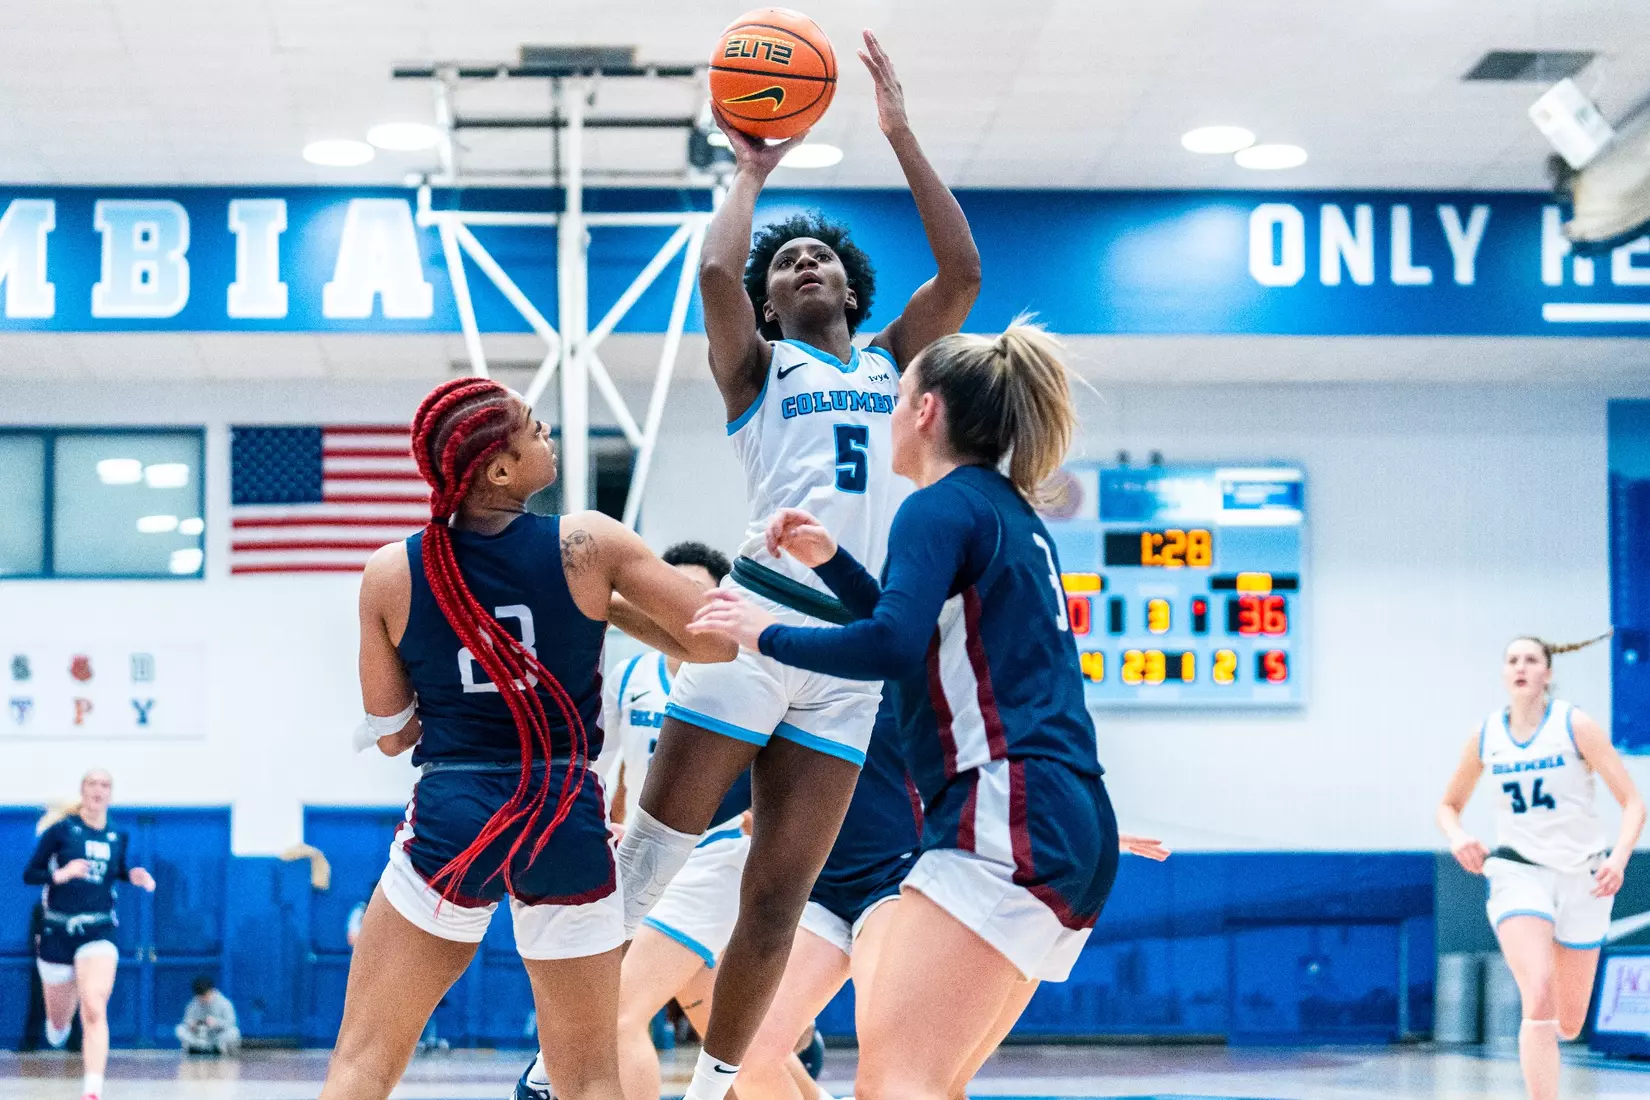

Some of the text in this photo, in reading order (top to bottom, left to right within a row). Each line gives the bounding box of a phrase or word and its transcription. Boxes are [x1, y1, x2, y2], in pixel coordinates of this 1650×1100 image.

[724, 38, 794, 66] ELITE
[1248, 202, 1491, 287] ONLY
[781, 389, 900, 420] COLUMBI
[832, 423, 870, 495] 5
[1140, 528, 1213, 568] 1:28
[1148, 599, 1170, 634] 3
[1238, 595, 1287, 636] 36
[457, 604, 539, 693] 23
[1213, 649, 1237, 685] 2
[1264, 650, 1287, 684] 5
[1502, 777, 1556, 814] 34
